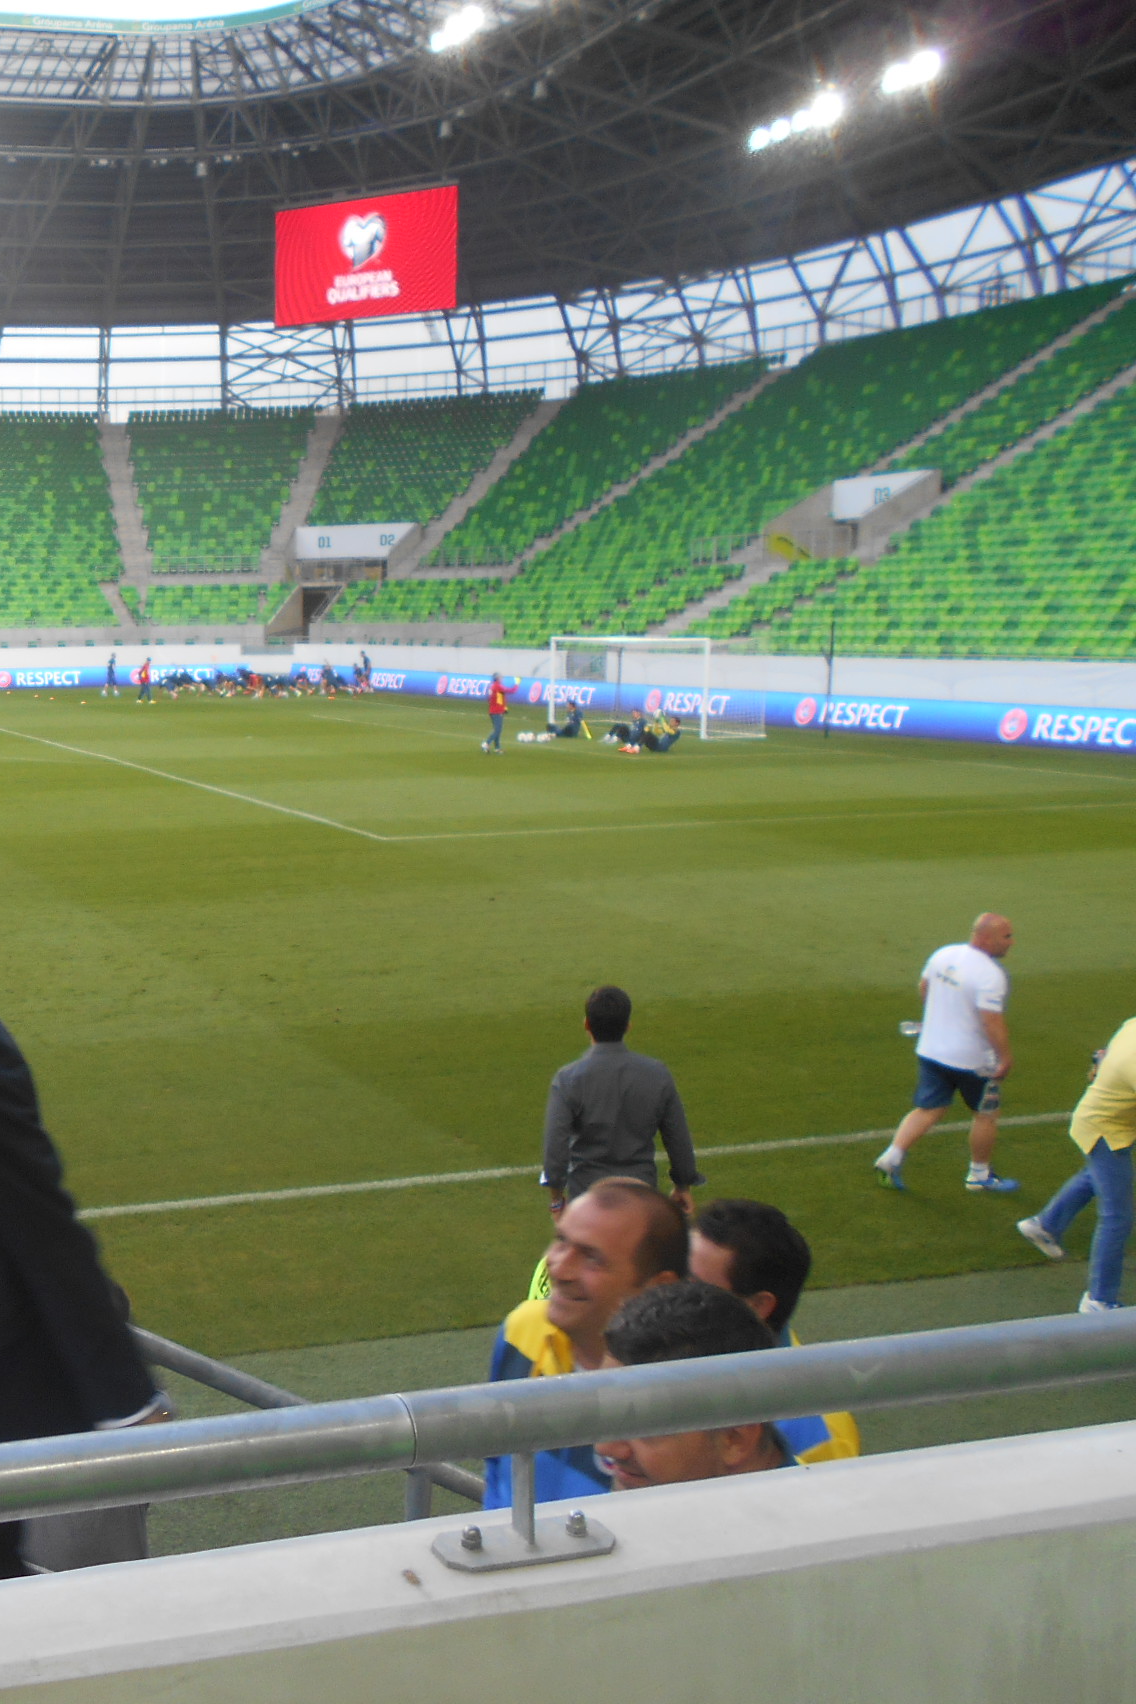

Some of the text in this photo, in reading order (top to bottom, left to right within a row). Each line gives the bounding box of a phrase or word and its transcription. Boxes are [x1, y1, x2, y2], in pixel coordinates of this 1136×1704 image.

[33, 16, 83, 28] Groupama
[142, 22, 193, 31] Groupama
[326, 280, 401, 305] QUALIFIERS
[380, 534, 395, 546] D2
[16, 670, 81, 686] RESPECT
[371, 672, 407, 688] RESPECT
[447, 678, 491, 695] RESPECT
[664, 692, 731, 715] RESPCT
[1032, 713, 1136, 745] RESPEC
